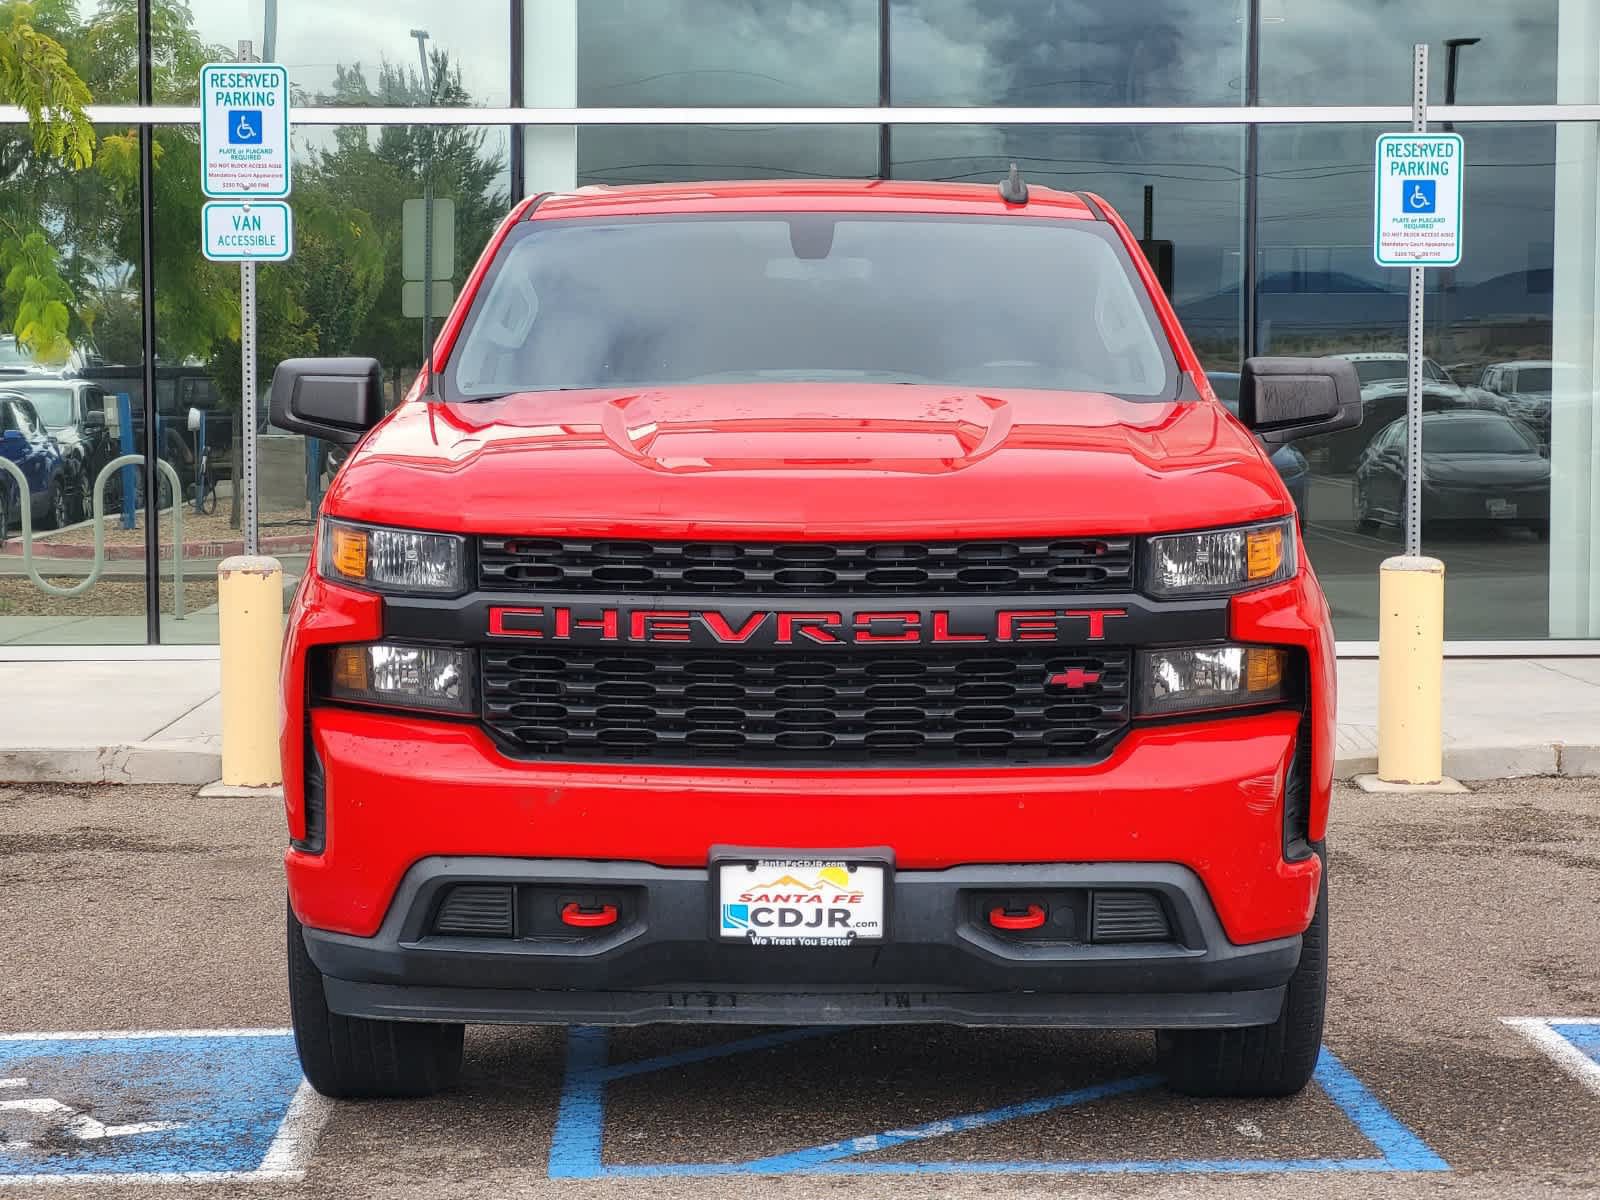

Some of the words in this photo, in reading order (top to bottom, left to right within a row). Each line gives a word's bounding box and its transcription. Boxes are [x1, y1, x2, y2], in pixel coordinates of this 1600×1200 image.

[210, 73, 280, 88] RESERVED
[215, 91, 275, 106] PARKING
[1386, 143, 1454, 158] RESERVED
[1390, 161, 1449, 176] PARKING
[232, 215, 261, 231] VAN
[217, 234, 277, 246] ACCESSIBLE
[486, 607, 1129, 646] CHEVROLET
[757, 859, 847, 868] SantaFeCDJR.com
[738, 894, 822, 904] SANTA
[832, 894, 864, 904] FE
[751, 936, 768, 946] We
[771, 936, 796, 946] Treat
[798, 936, 818, 946] You
[820, 936, 853, 946] Better
